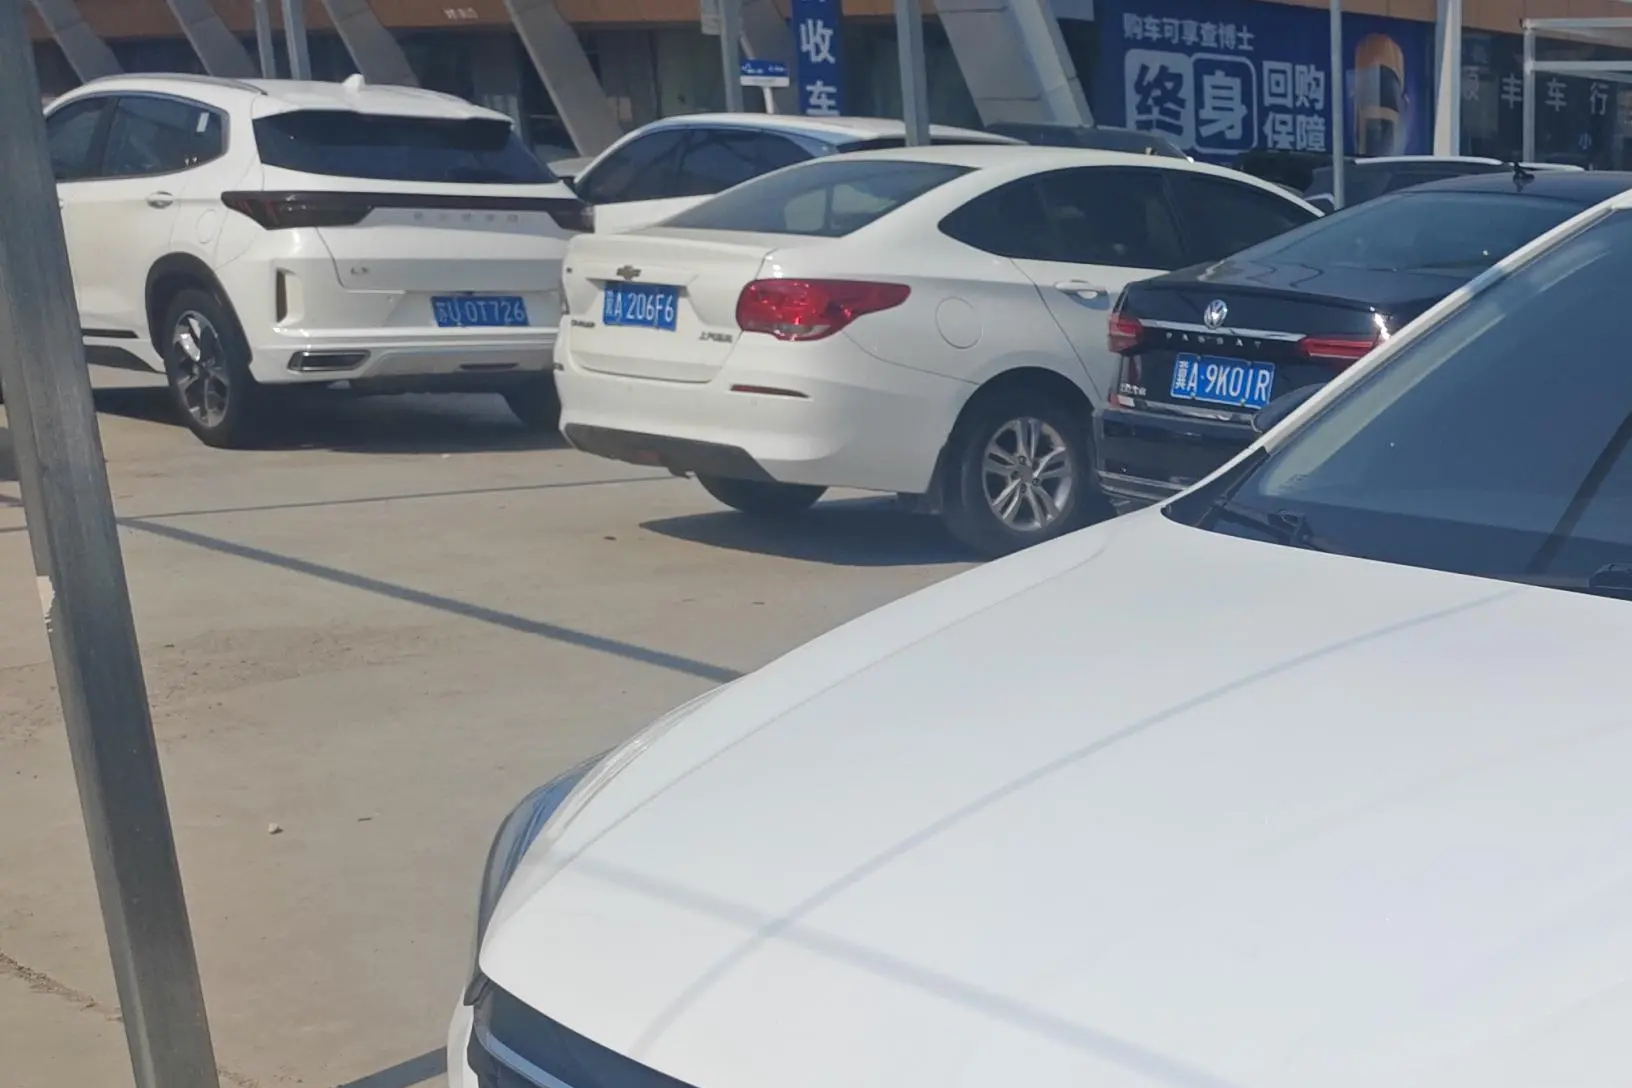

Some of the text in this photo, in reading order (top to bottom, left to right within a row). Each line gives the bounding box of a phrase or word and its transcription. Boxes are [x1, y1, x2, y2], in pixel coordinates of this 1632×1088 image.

[1123, 13, 1255, 50] 购车可享查博士
[800, 0, 840, 116] 收车
[1133, 63, 1248, 140] 终身
[1262, 60, 1325, 110] 回购
[1262, 111, 1326, 152] 保障
